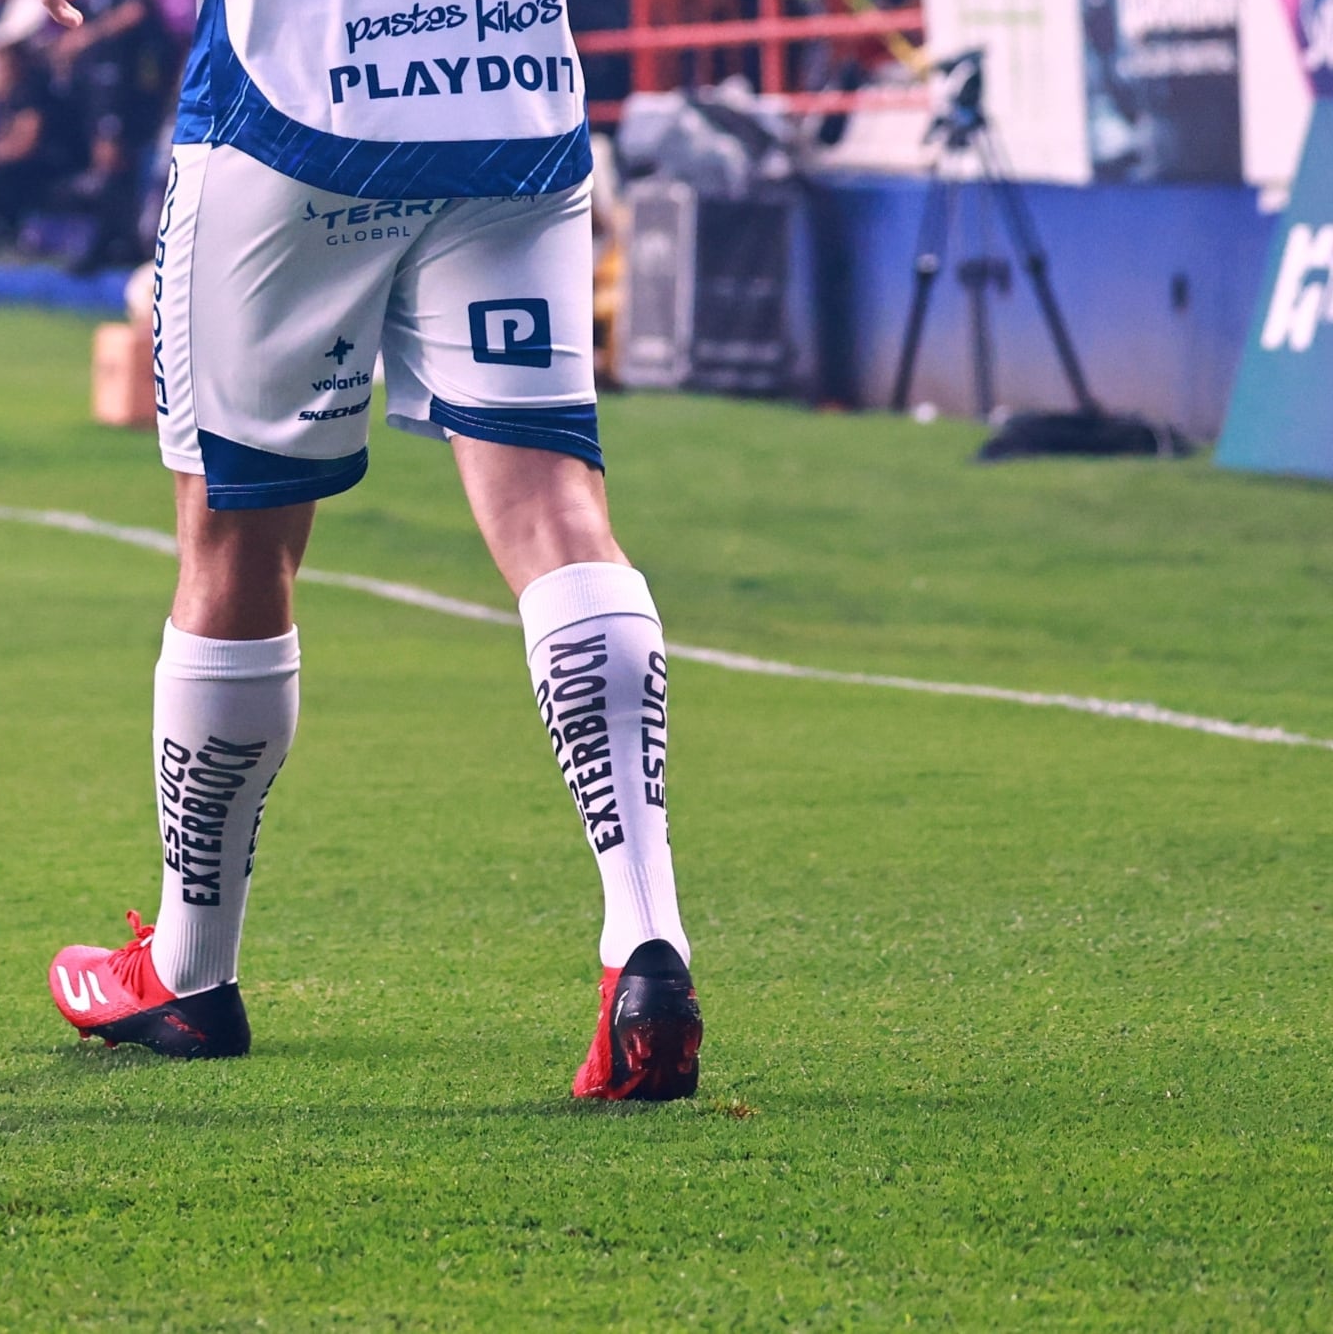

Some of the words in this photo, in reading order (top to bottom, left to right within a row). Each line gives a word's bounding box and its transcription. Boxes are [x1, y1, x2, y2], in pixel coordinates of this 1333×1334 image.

[345, 2, 469, 55] pastes
[326, 225, 411, 246] GLOBAL
[311, 370, 370, 392] volaris
[549, 633, 626, 855] EXTERBLOCK
[641, 650, 669, 809] ESTUCO
[160, 737, 192, 873] ESTUCO
[181, 735, 268, 907] EXTERBLOCK
